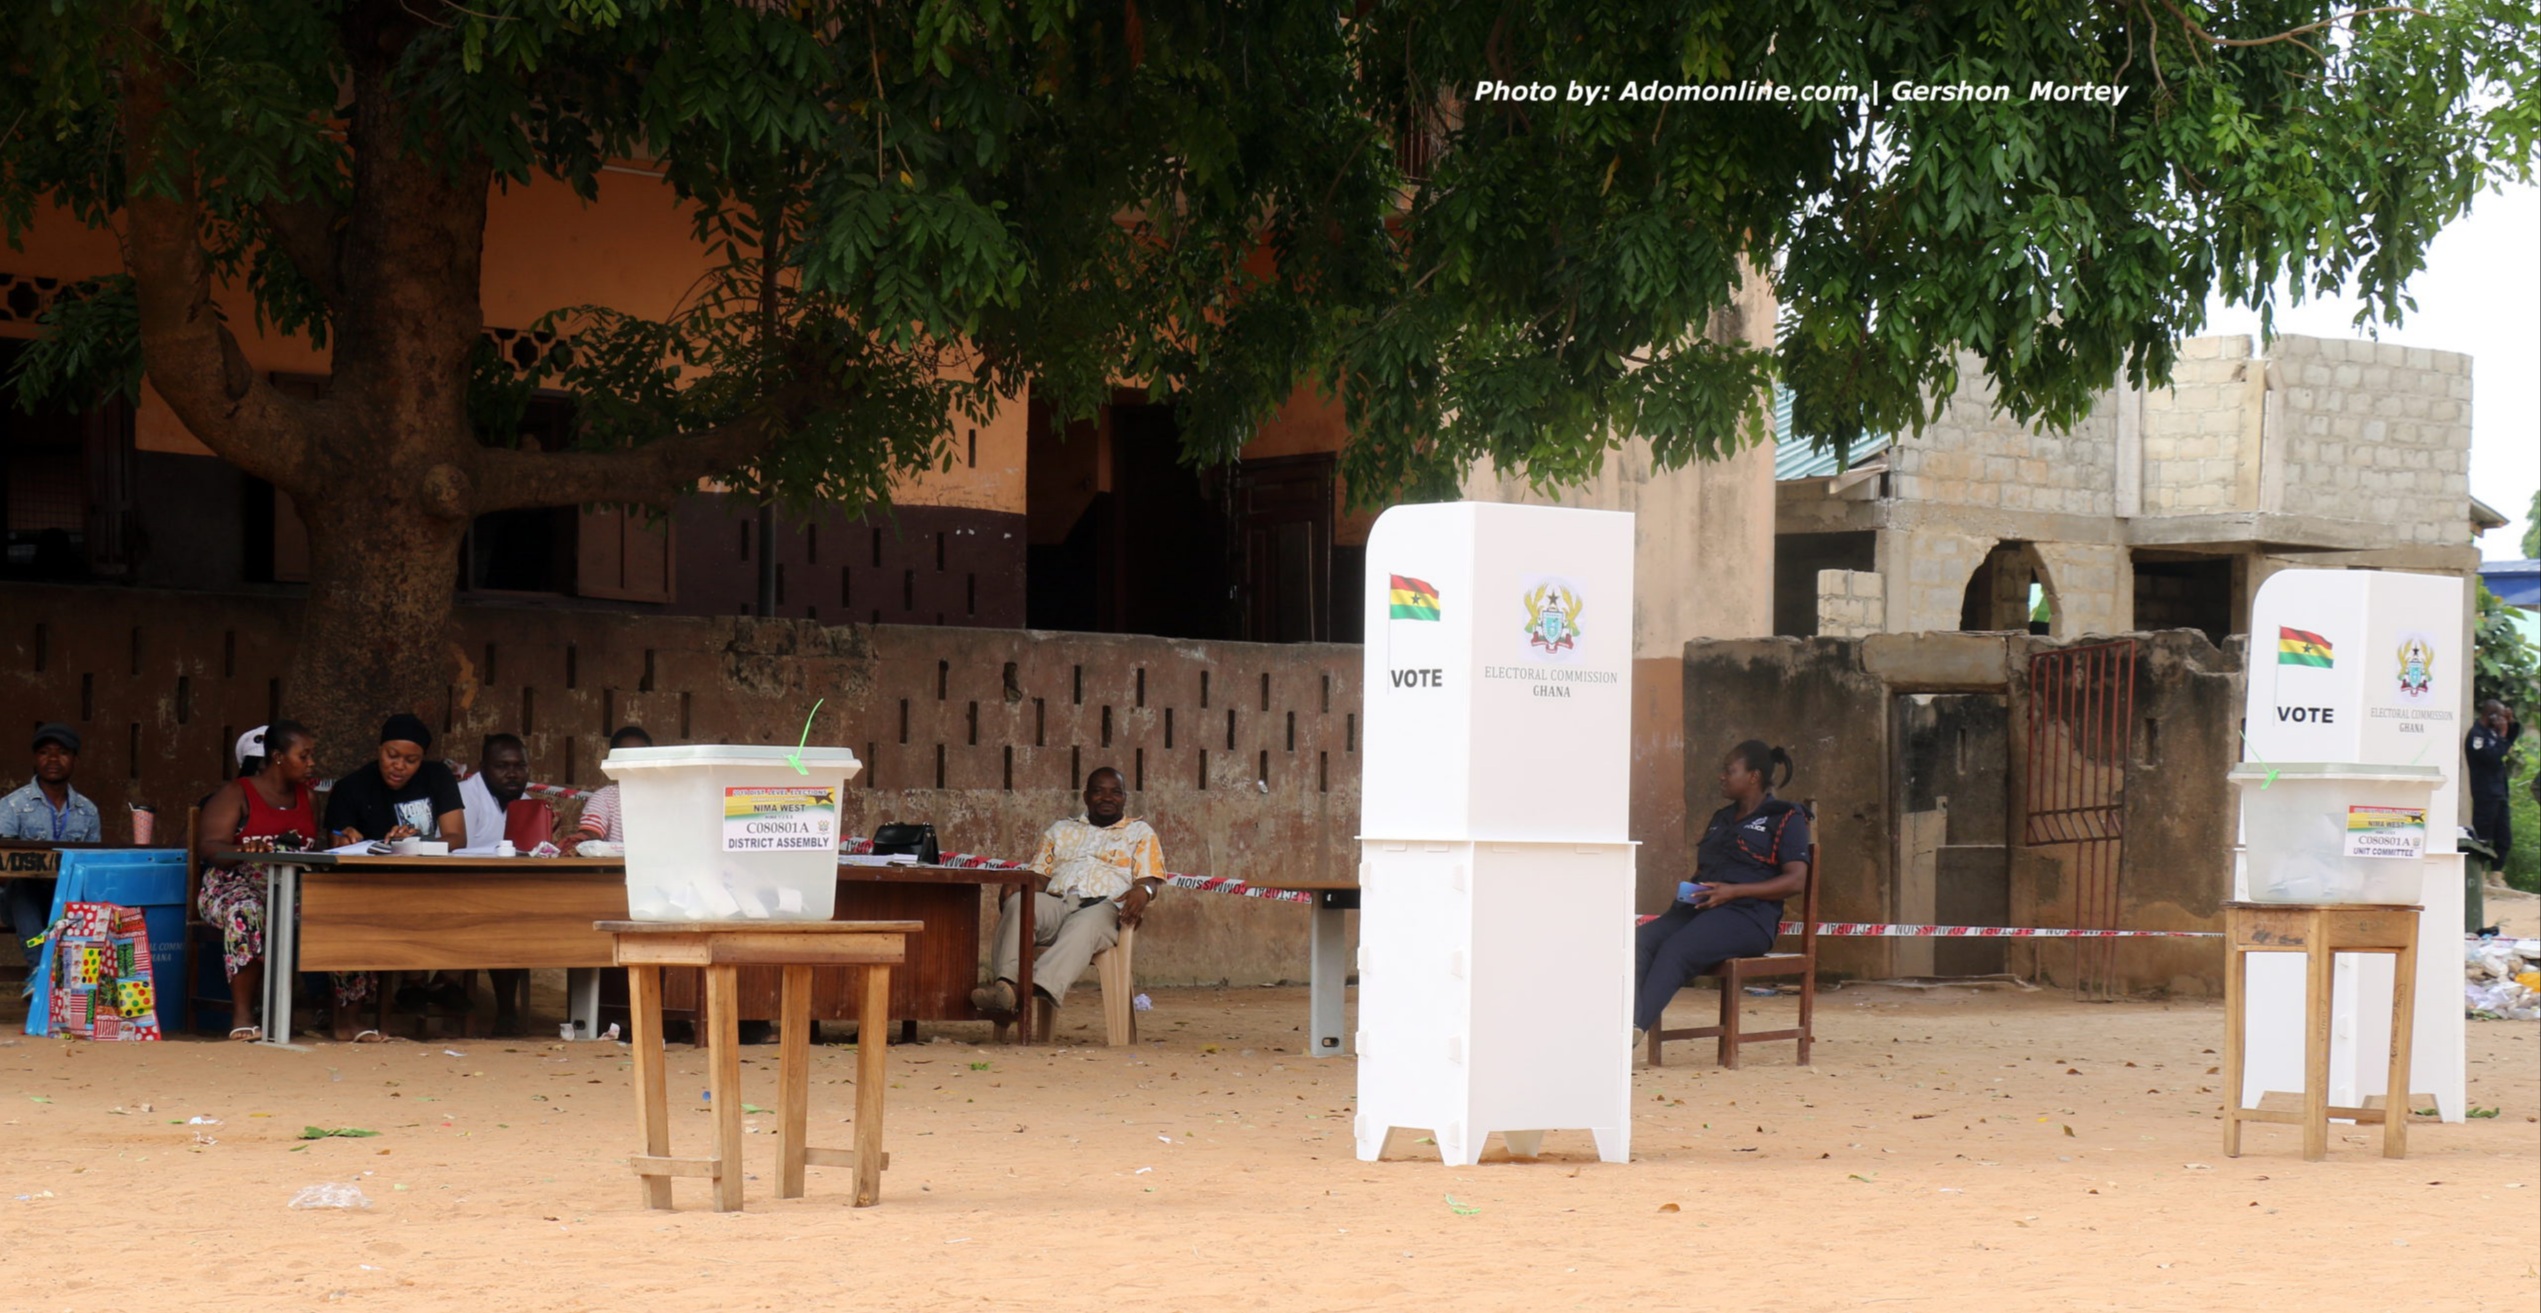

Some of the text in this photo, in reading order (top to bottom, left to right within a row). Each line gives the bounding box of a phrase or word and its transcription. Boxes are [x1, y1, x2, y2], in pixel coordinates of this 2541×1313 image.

[1390, 668, 1443, 688] VOTE
[1484, 666, 1618, 684] ELECTORAL COMMISSION
[1532, 684, 1571, 698] GHANA
[2276, 706, 2335, 724] VOTE
[2370, 707, 2453, 721] ELECTORAL COMMISSION
[2399, 722, 2425, 733] GHANA
[753, 804, 806, 812] NIMA WEST
[746, 822, 809, 834] C080801A
[728, 837, 830, 849] DISTRICT ASSEMBLY
[2353, 847, 2414, 857] UNIT COMMITTEE
[1176, 877, 1248, 896] COMMISSION
